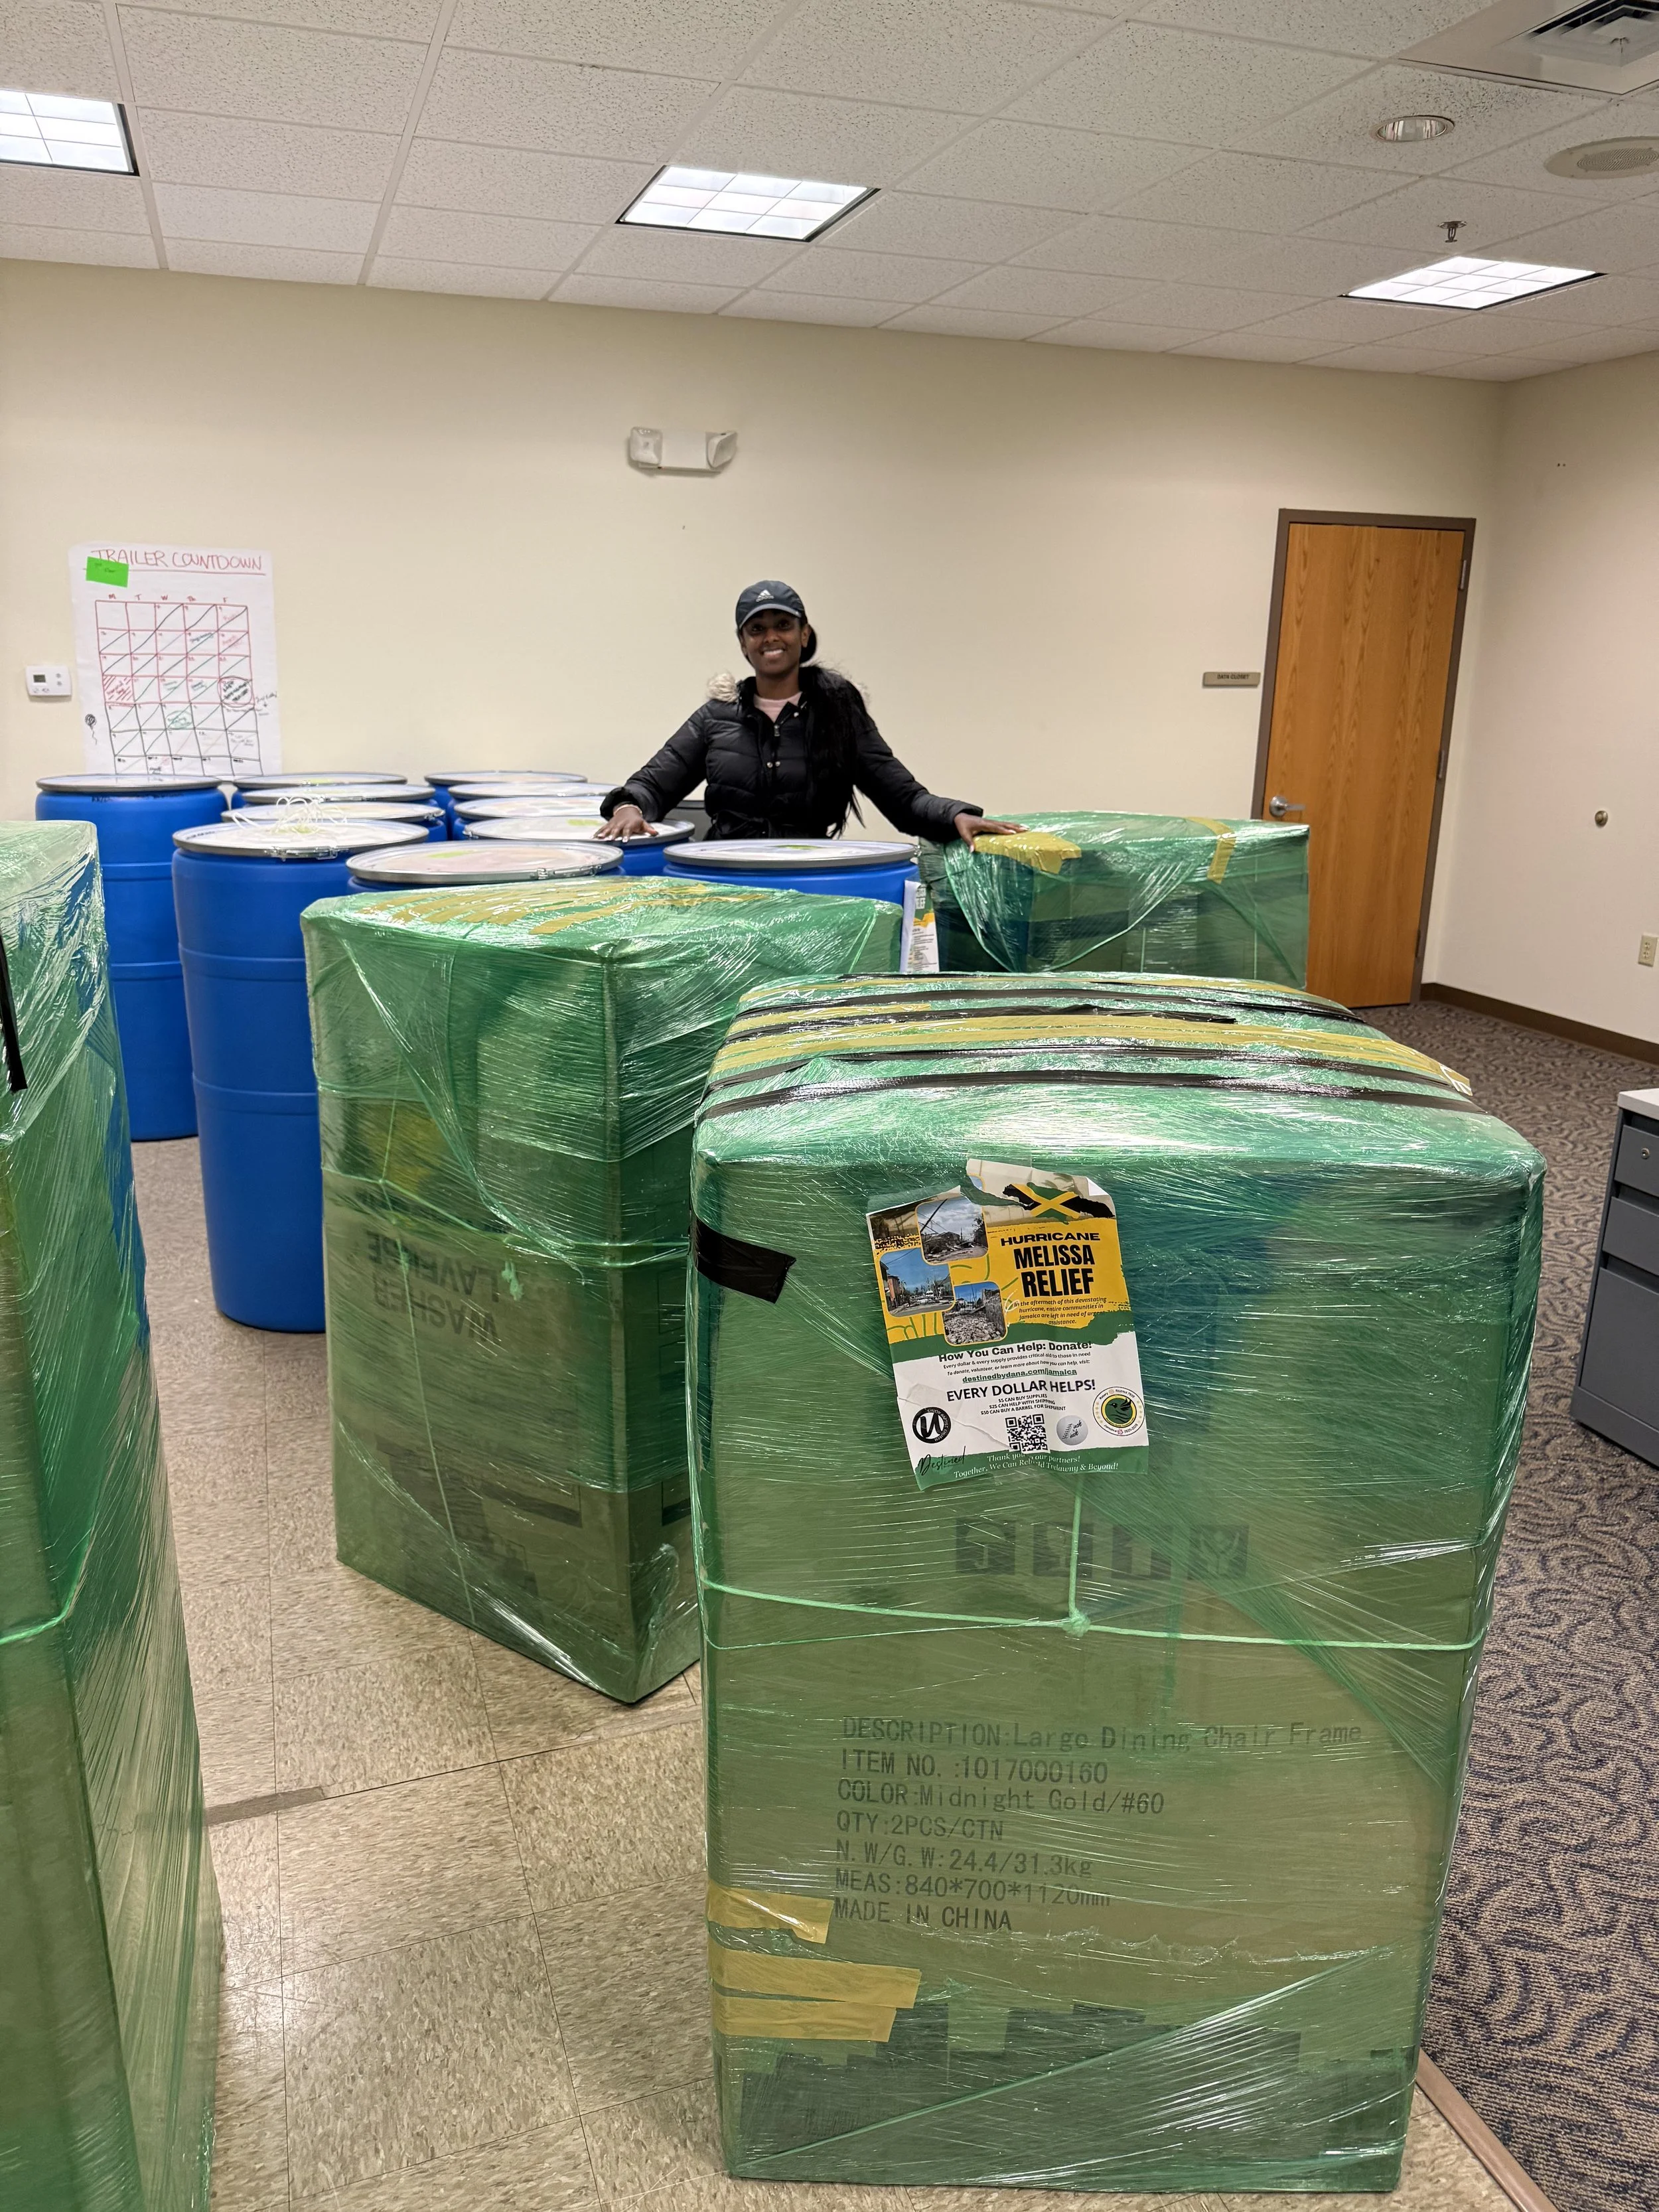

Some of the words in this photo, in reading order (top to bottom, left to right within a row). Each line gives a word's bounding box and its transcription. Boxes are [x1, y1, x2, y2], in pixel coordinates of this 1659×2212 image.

[92, 549, 167, 568] TRAILER
[173, 552, 264, 571] COUNTDOWN
[1001, 1232, 1101, 1246] HURRICANE
[1013, 1244, 1095, 1269] MELISSA
[1021, 1268, 1094, 1297] RELIEF
[938, 1353, 964, 1363] How
[966, 1349, 989, 1358] You
[992, 1347, 1014, 1355] Can
[1017, 1342, 1046, 1352] Help:
[1048, 1341, 1092, 1351] Donate!
[962, 1368, 1077, 1382] destinedbydana.com/jamaica
[947, 1386, 987, 1402] EVERY
[992, 1380, 1048, 1396] DOLLAR
[1050, 1379, 1096, 1392] HELPS!
[918, 1445, 966, 1475] Destined
[987, 1453, 1011, 1462] Thank
[1088, 1462, 1118, 1471] Beyond!
[1102, 1726, 1190, 1753] Dining
[1204, 1725, 1276, 1748] Chair
[1290, 1722, 1362, 1745] Frame
[842, 1748, 895, 1774] ITEM
[1048, 1788, 1165, 1815] Gold/#60
[837, 1810, 1003, 1841] QTY:2PCS/CTN
[833, 1897, 891, 1923] MADE
[906, 1902, 929, 1925] IN
[942, 1905, 1013, 1931] CHINA
